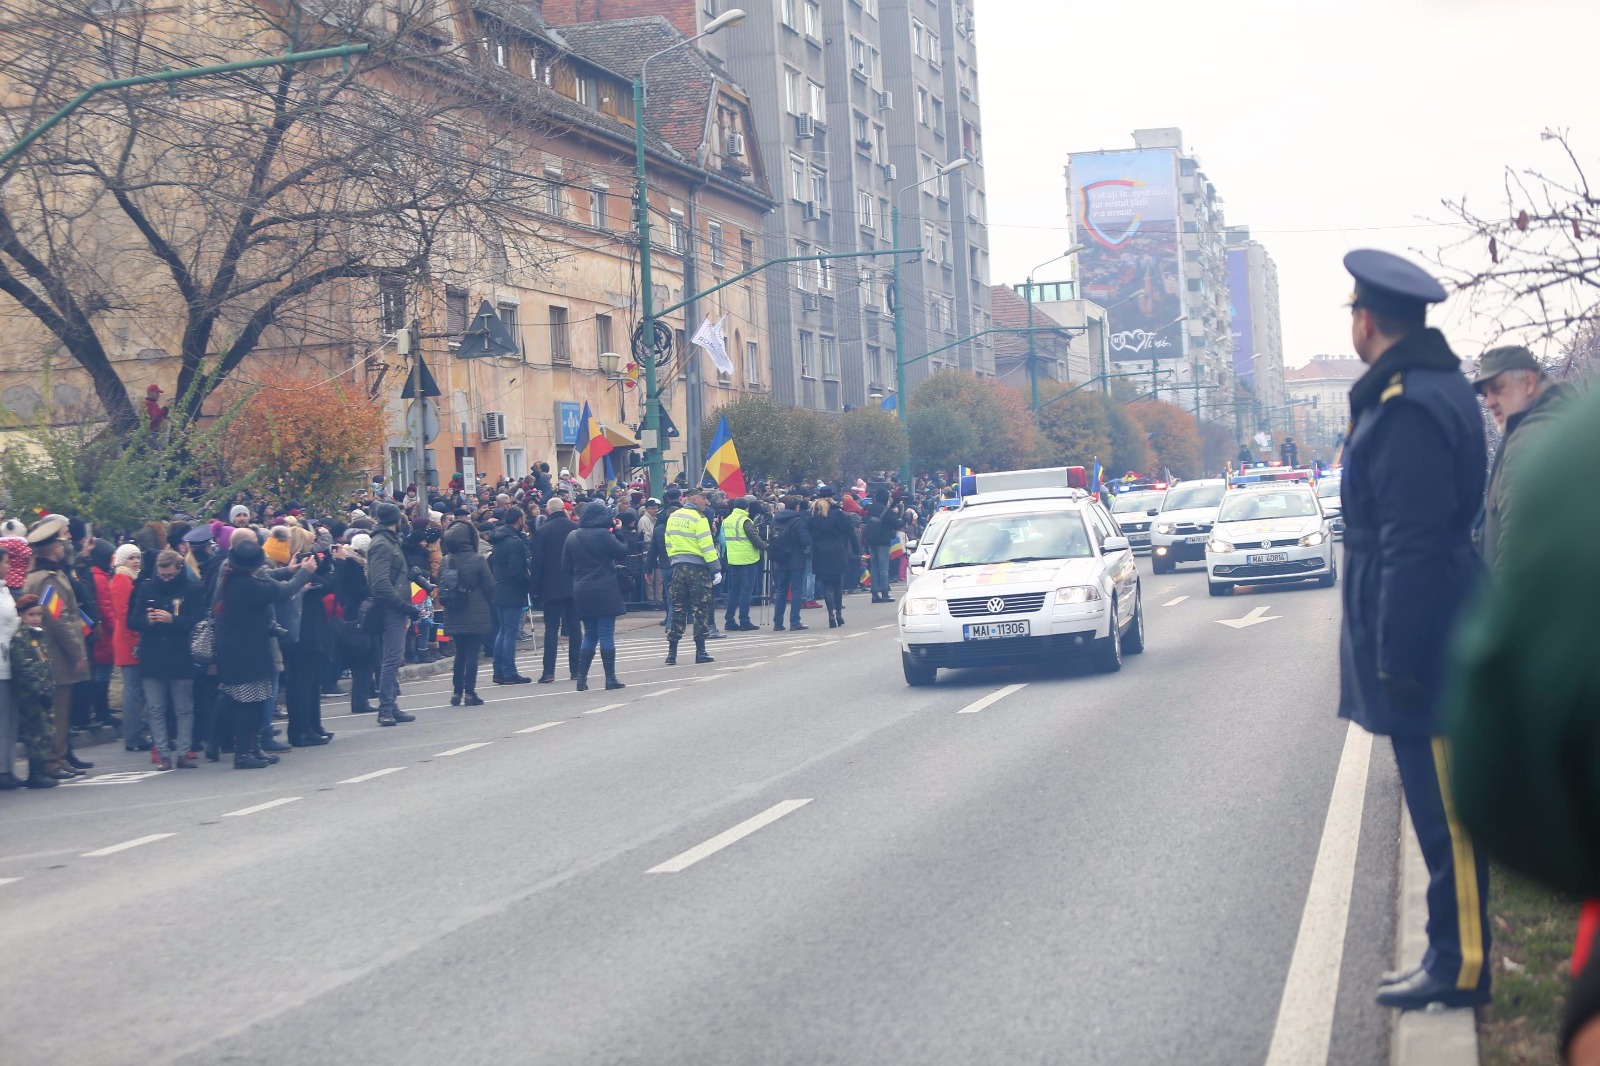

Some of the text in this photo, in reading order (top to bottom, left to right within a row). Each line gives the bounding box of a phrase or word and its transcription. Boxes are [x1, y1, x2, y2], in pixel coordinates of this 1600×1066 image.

[1105, 198, 1128, 207] restul
[1107, 208, 1135, 217] urmat.
[1266, 554, 1285, 562] 40814
[972, 622, 1025, 637] MAI 11306
